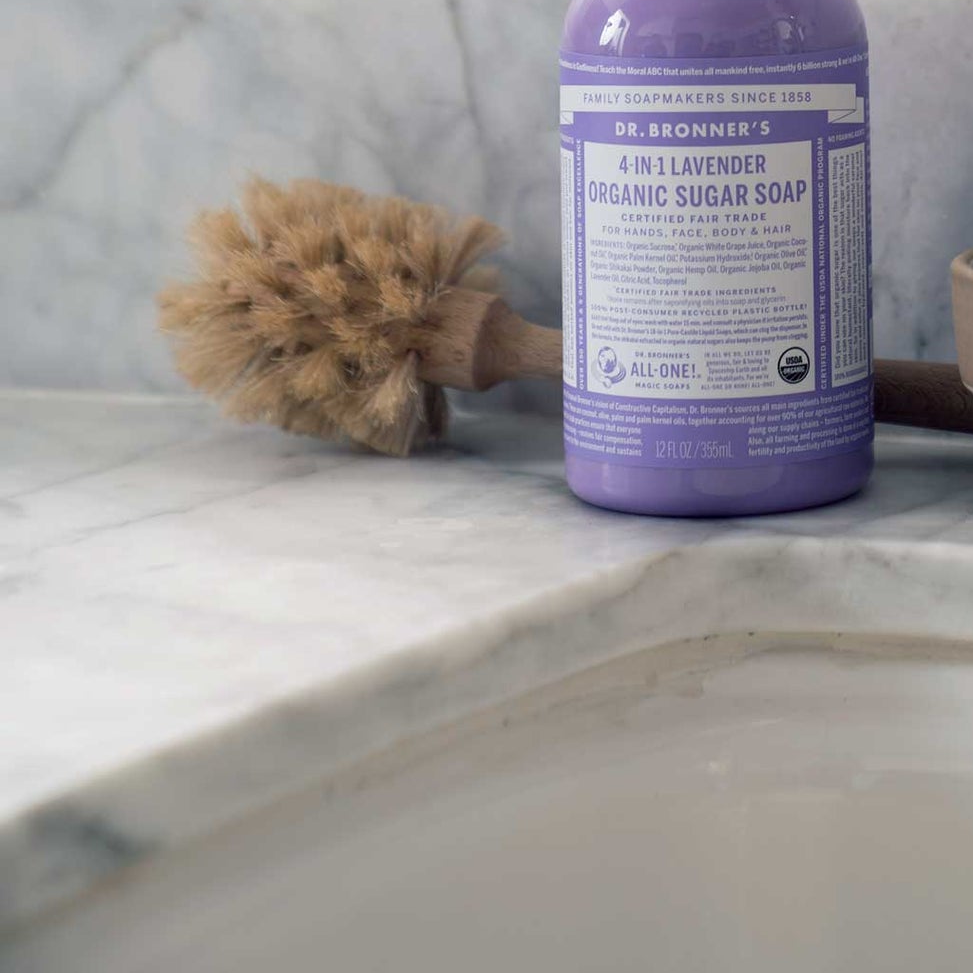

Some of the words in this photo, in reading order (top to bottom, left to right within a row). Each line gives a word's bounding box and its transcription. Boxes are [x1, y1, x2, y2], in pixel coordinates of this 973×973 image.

[663, 68, 679, 76] that
[715, 67, 748, 75] mankind
[583, 93, 620, 104] FAMILY
[625, 92, 725, 104] SOAPMAKERS
[731, 92, 776, 103] SINCE
[782, 91, 812, 103] 1858
[615, 121, 645, 137] DR.
[619, 155, 666, 176] 4-IN-1
[671, 154, 766, 176] LAVENDER
[588, 180, 667, 207] ORGANIC
[675, 183, 754, 207] SUGAR
[755, 180, 807, 206] SOAP
[621, 213, 685, 224] CERTIFIED
[690, 214, 719, 224] FAIR
[724, 212, 767, 223] TRADE
[624, 227, 668, 238] HANDS,
[672, 229, 708, 238] FACE,
[712, 227, 746, 237] BODY
[750, 227, 758, 236] &
[763, 224, 792, 235] HAIR
[716, 287, 776, 296] INGREDIENTS
[681, 308, 729, 316] RECYCLED
[732, 307, 769, 315] PLASTIC
[785, 355, 803, 365] USDA
[631, 361, 696, 379] ALL-ONE!
[820, 345, 828, 389] CERTIFIED
[663, 382, 690, 390] SOAPS
[656, 440, 666, 458] 12
[667, 441, 679, 459] FL
